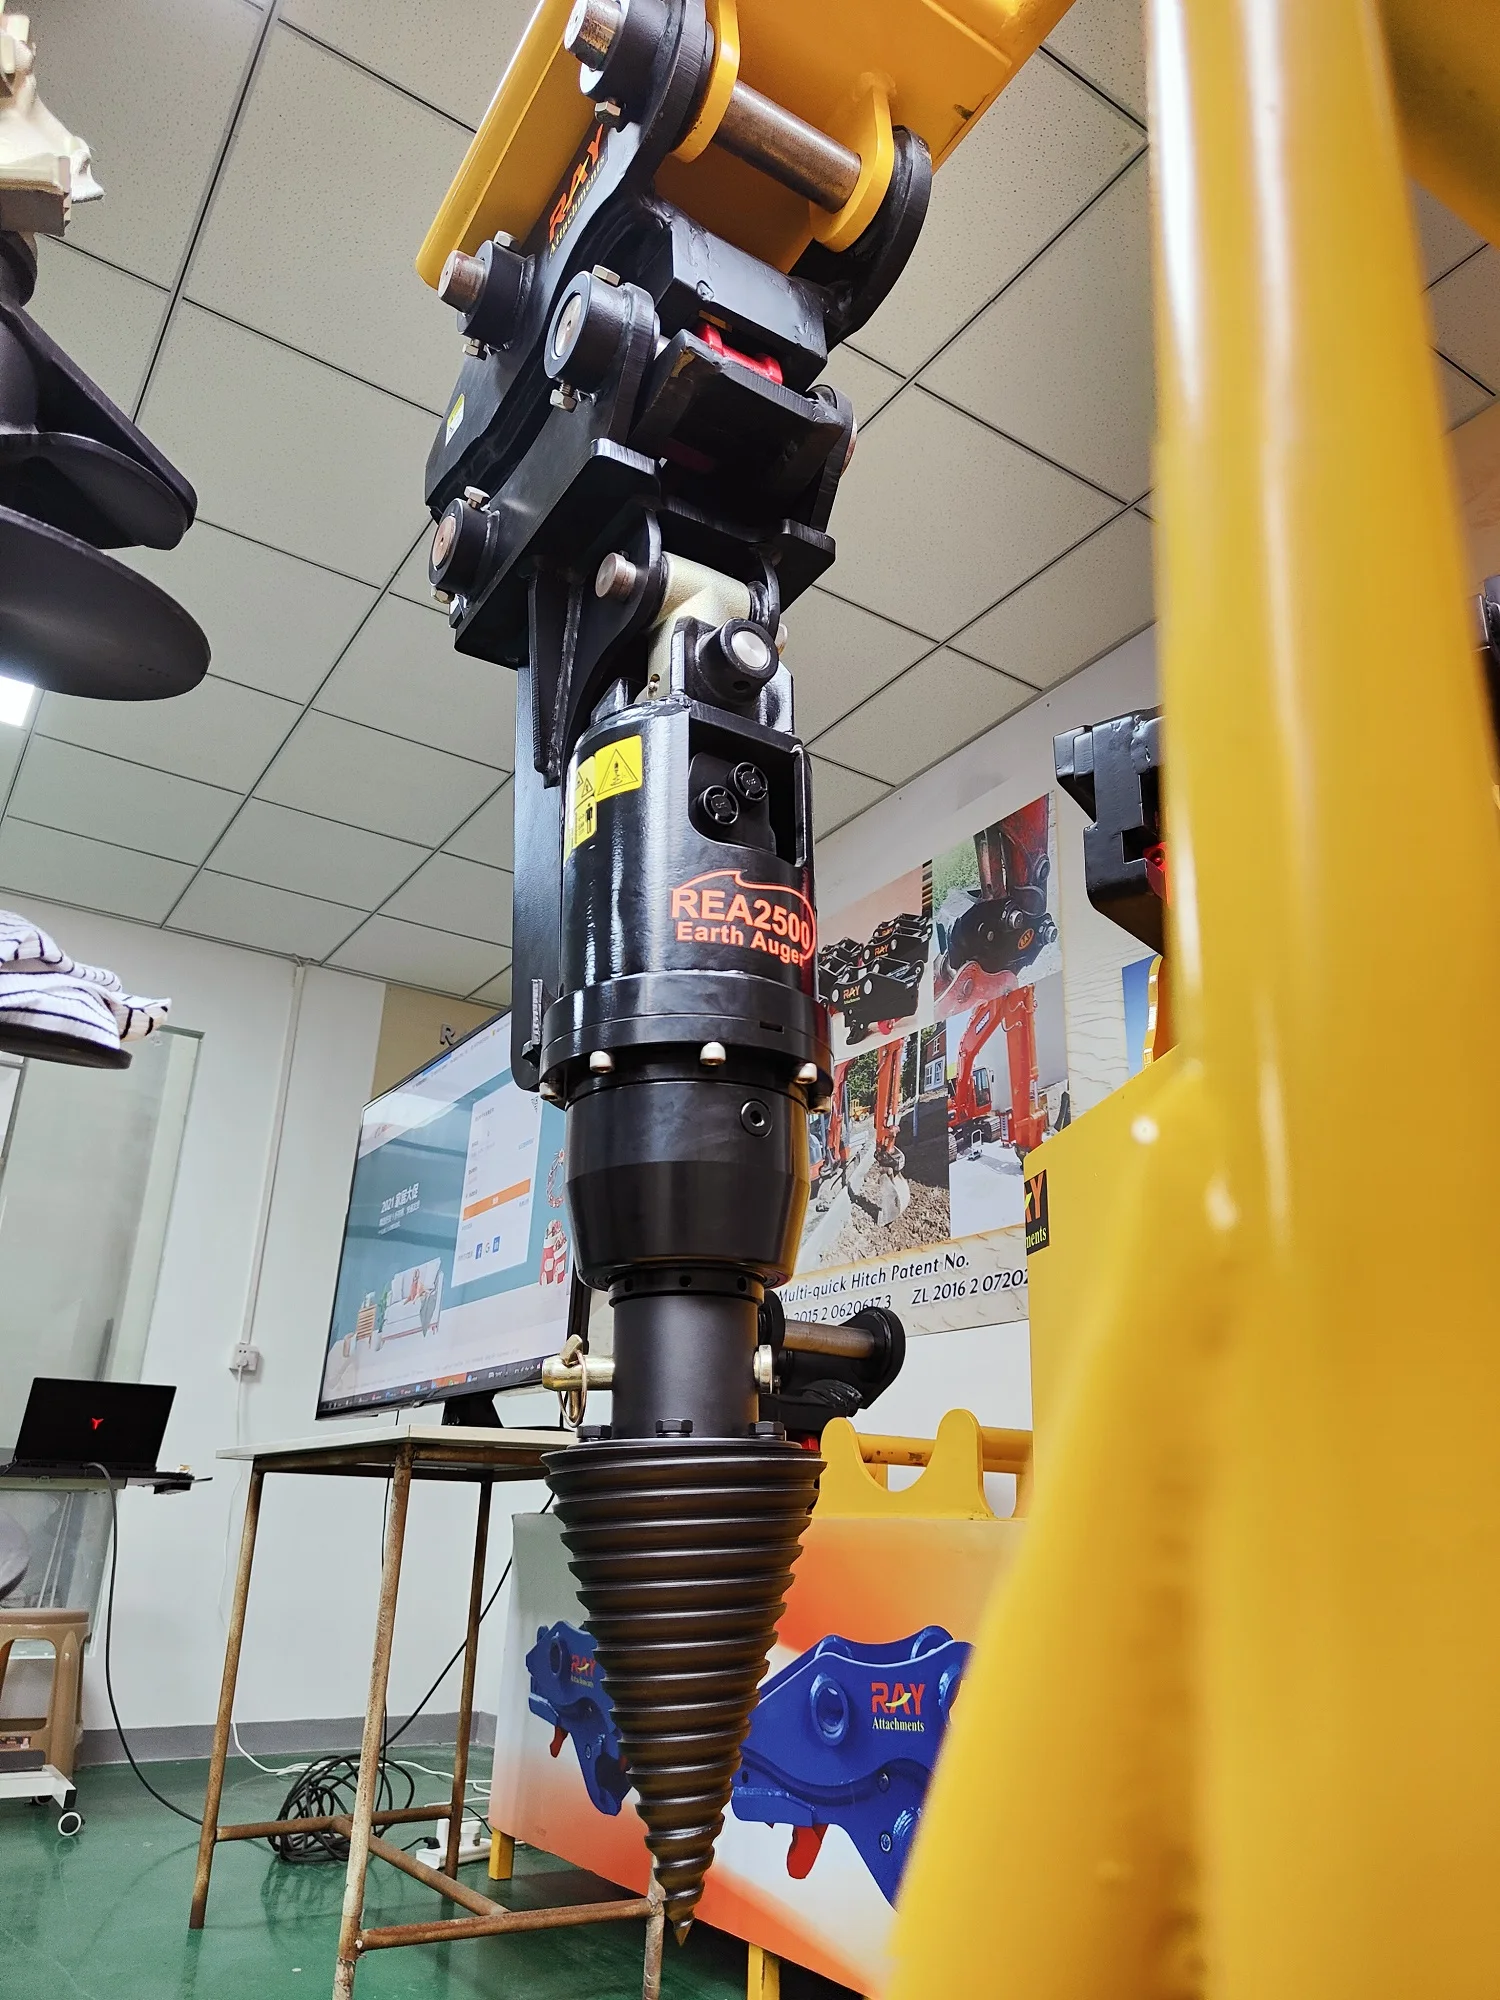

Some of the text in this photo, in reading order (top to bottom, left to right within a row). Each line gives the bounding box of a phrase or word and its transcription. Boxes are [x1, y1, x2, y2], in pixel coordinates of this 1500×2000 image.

[549, 123, 604, 243] RAY
[549, 154, 605, 260] Attachments
[671, 889, 810, 950] REA2500
[676, 921, 807, 968] Earth Auger
[874, 944, 890, 957] RAY
[843, 985, 861, 1000] RAY
[1026, 1226, 1047, 1249] ments
[779, 1252, 970, 1302] Multi-quick Hitch Patent No.
[911, 1288, 929, 1305] ZL
[933, 1280, 966, 1301] 2016
[969, 1277, 979, 1295] 2
[820, 1306, 829, 1321] 2
[831, 1294, 891, 1319] 06206173
[571, 1653, 596, 1677] RAY
[871, 1682, 926, 1716] RAY
[872, 1716, 925, 1732] Attachments
